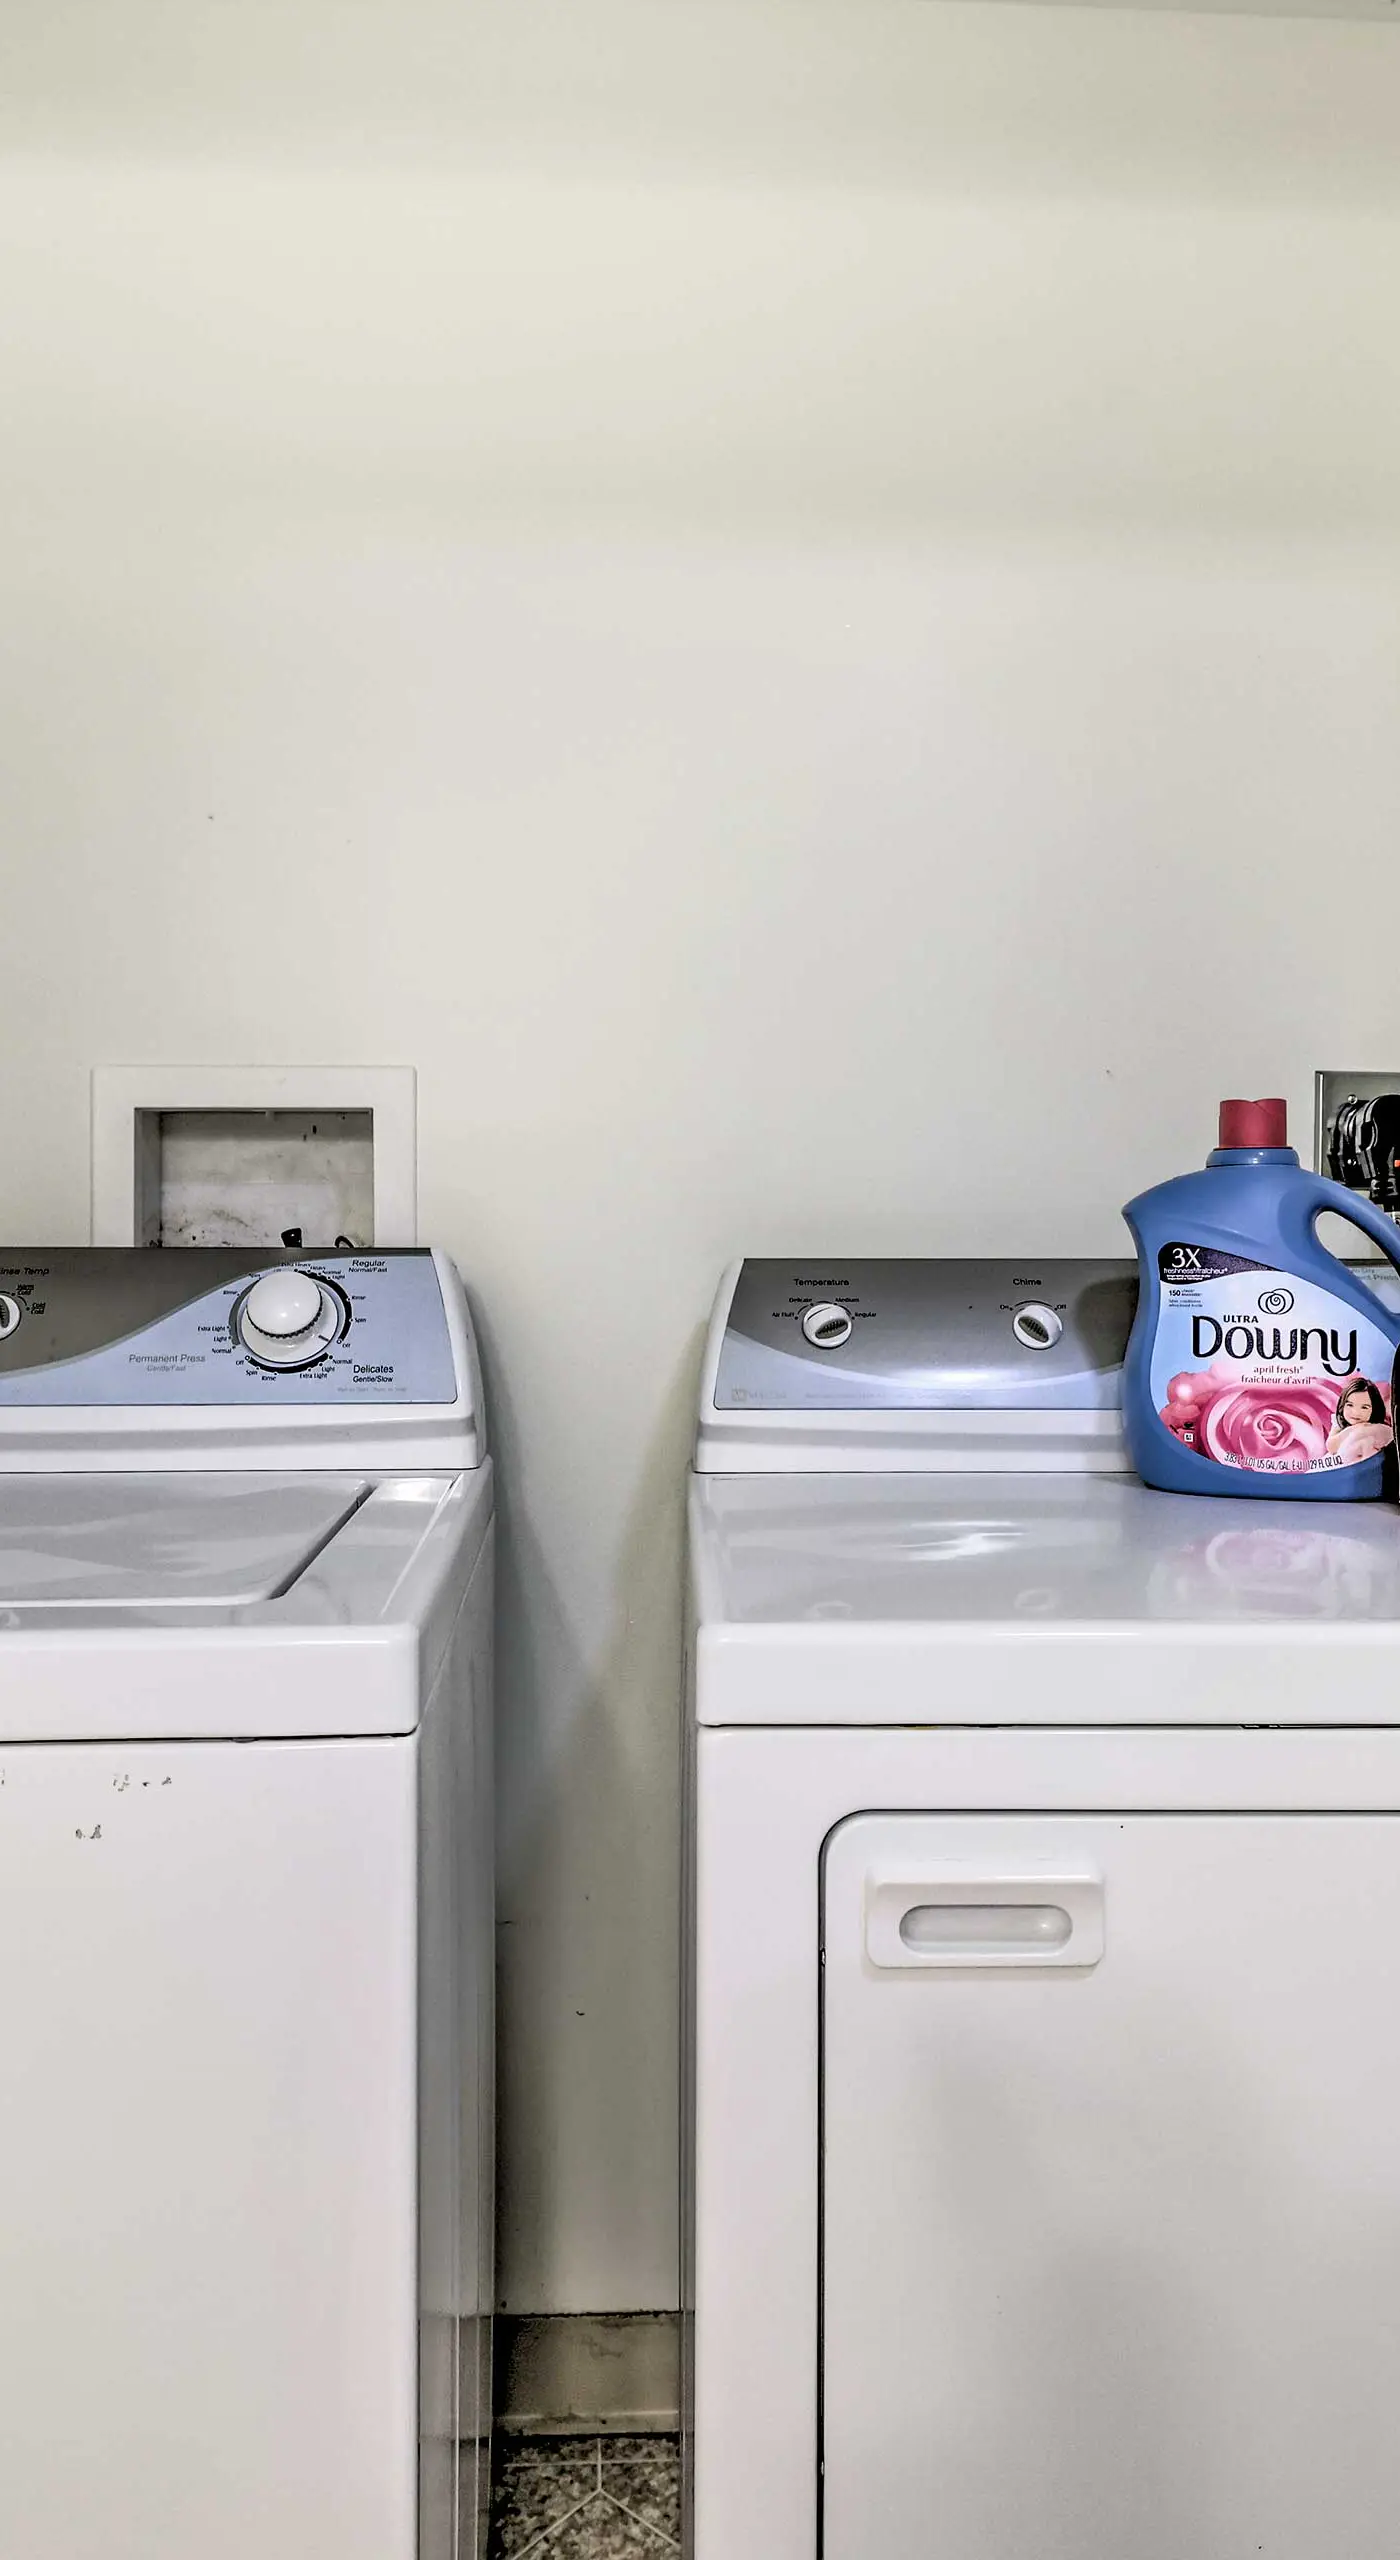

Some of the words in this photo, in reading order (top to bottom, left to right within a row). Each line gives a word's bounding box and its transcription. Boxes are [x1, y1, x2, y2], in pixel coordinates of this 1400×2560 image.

[1171, 1247, 1202, 1268] 3X
[352, 1260, 386, 1268] Regular
[24, 1266, 50, 1277] Temp
[793, 1278, 850, 1287] Temperature
[1012, 1278, 1042, 1286] Chime
[1168, 1289, 1181, 1297] 150
[1223, 1314, 1259, 1324] ULTRA
[1191, 1314, 1358, 1377] Downy
[129, 1353, 178, 1363] Permanent
[180, 1353, 206, 1362] Press
[353, 1364, 394, 1374] Delicates
[1253, 1365, 1275, 1375] april
[352, 1375, 394, 1383] Gentle/Slow
